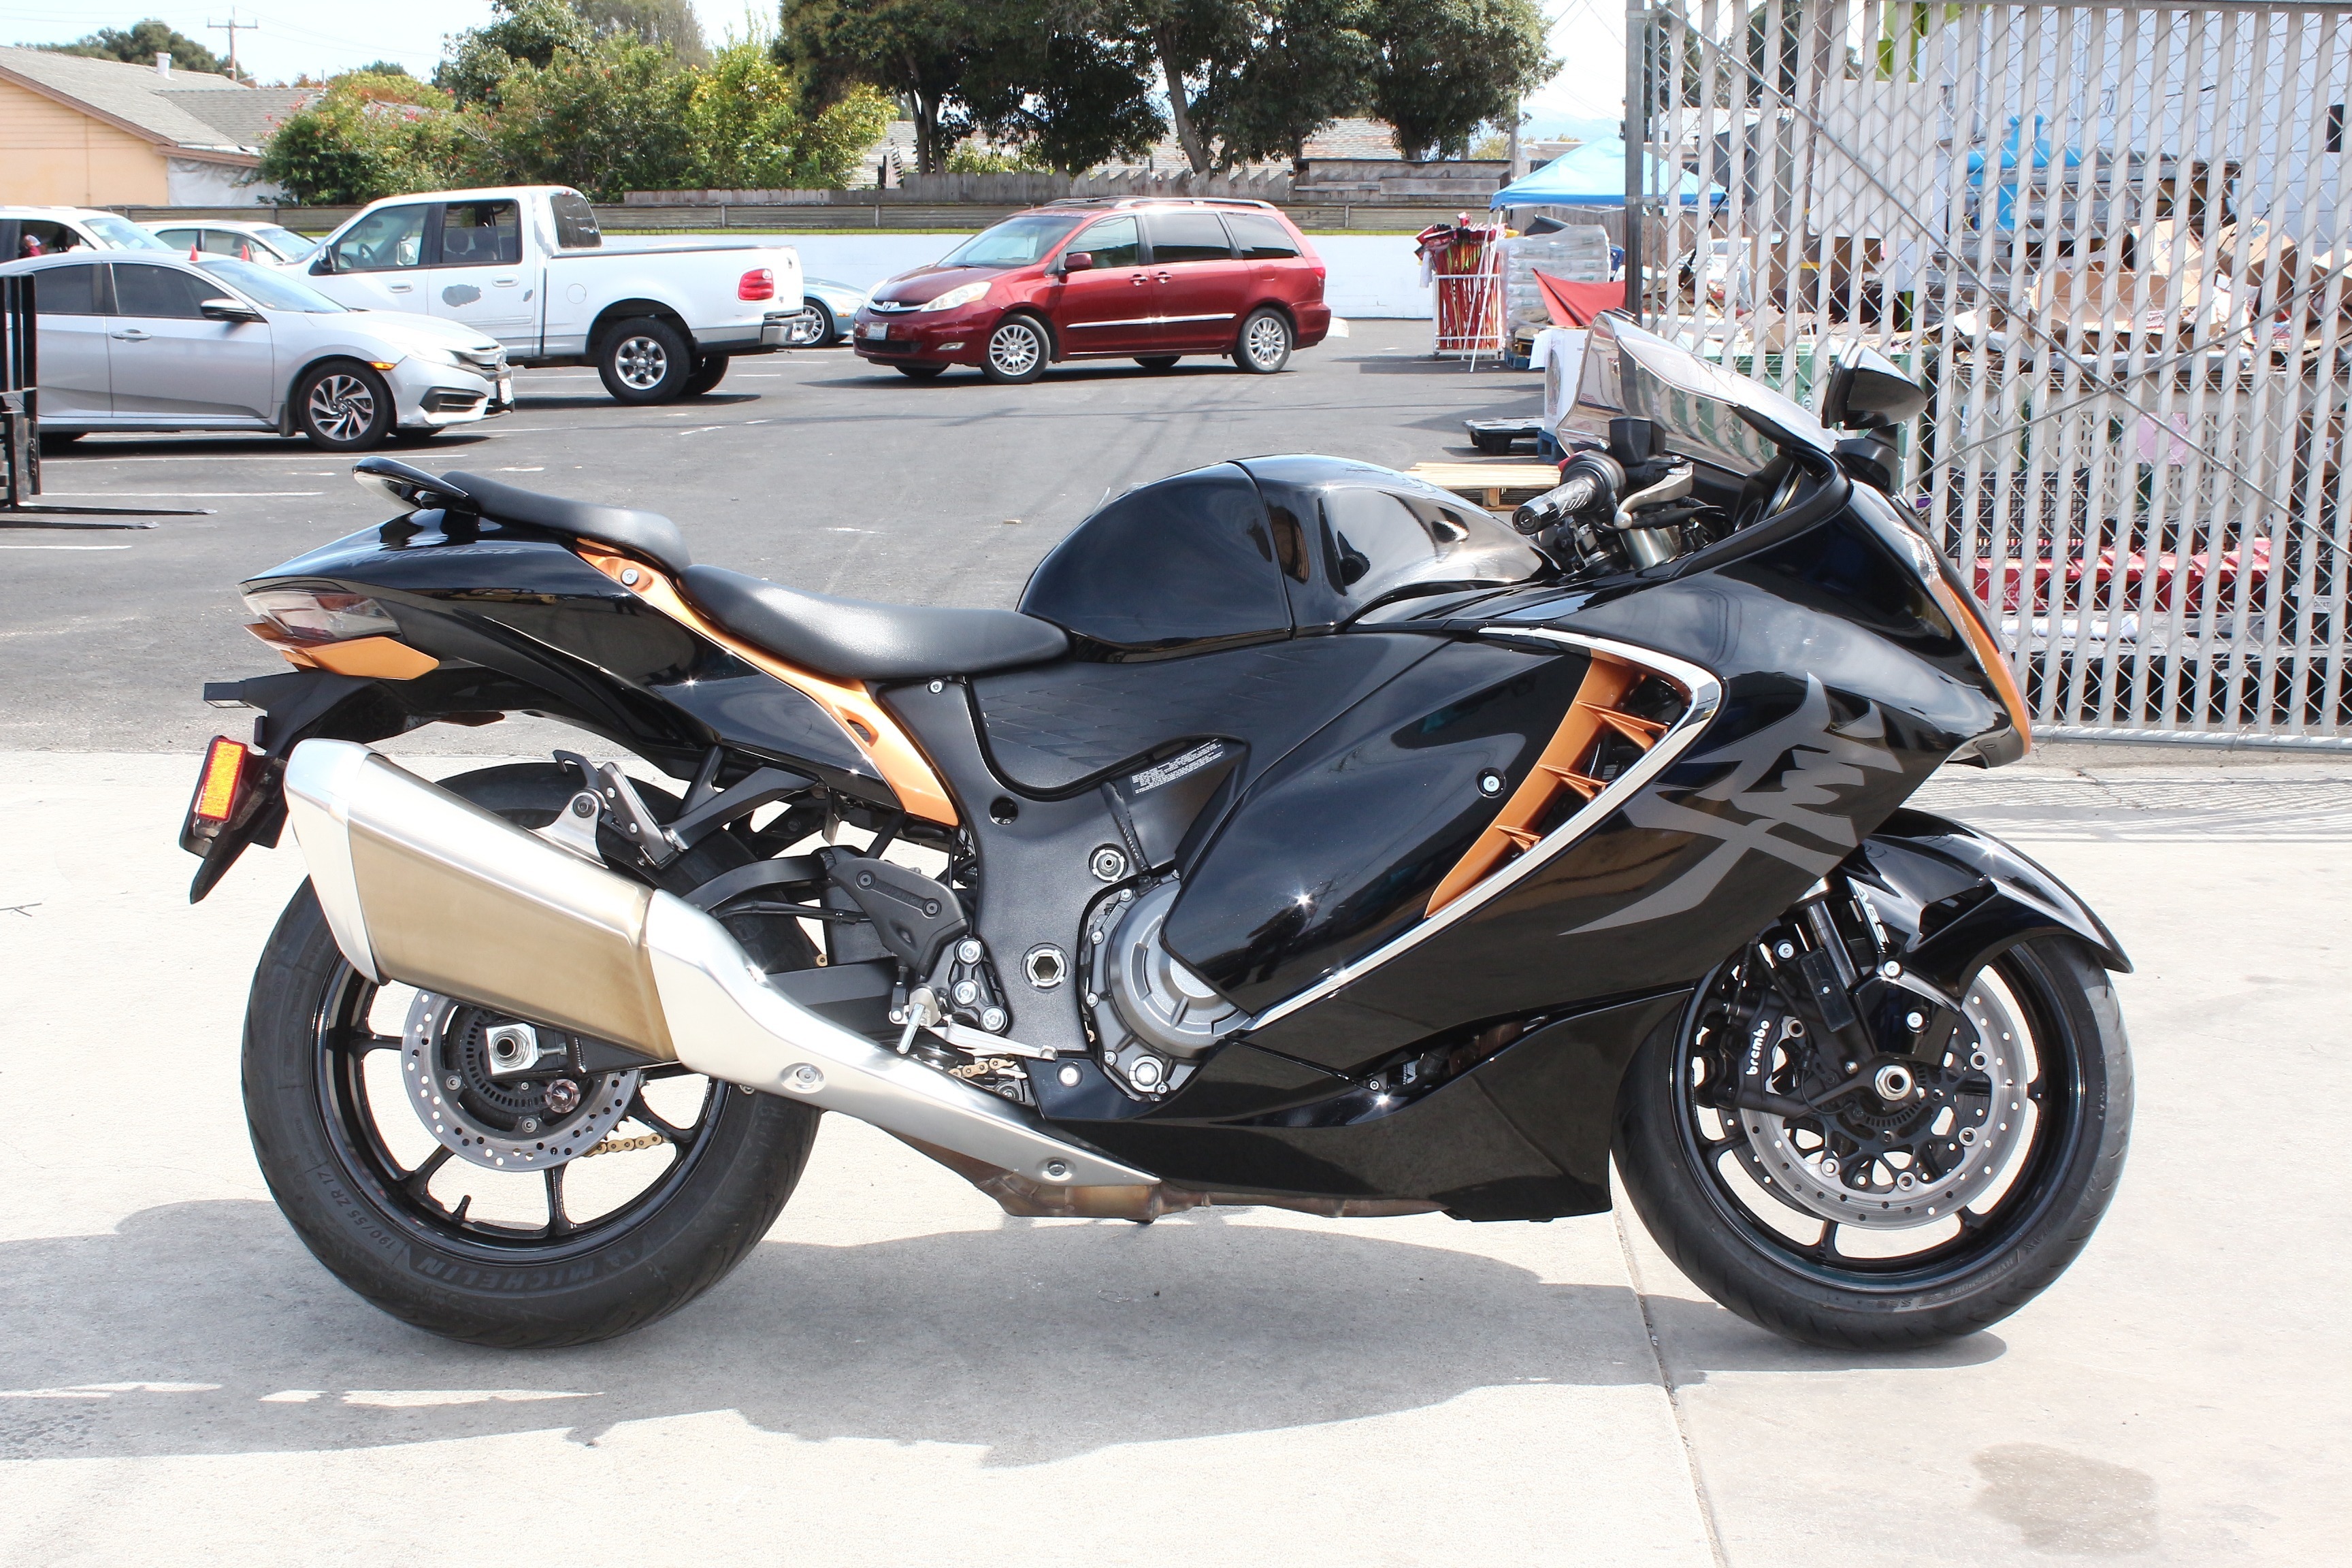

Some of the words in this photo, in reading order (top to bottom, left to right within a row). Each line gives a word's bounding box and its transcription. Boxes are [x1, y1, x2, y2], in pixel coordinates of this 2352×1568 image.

[1852, 880, 1890, 947] ABS
[1746, 1020, 1769, 1075] brembo
[317, 1171, 335, 1186] 17
[331, 1188, 352, 1208] ZR
[347, 1209, 396, 1250] 190/55
[417, 1256, 595, 1290] MICHELIN
